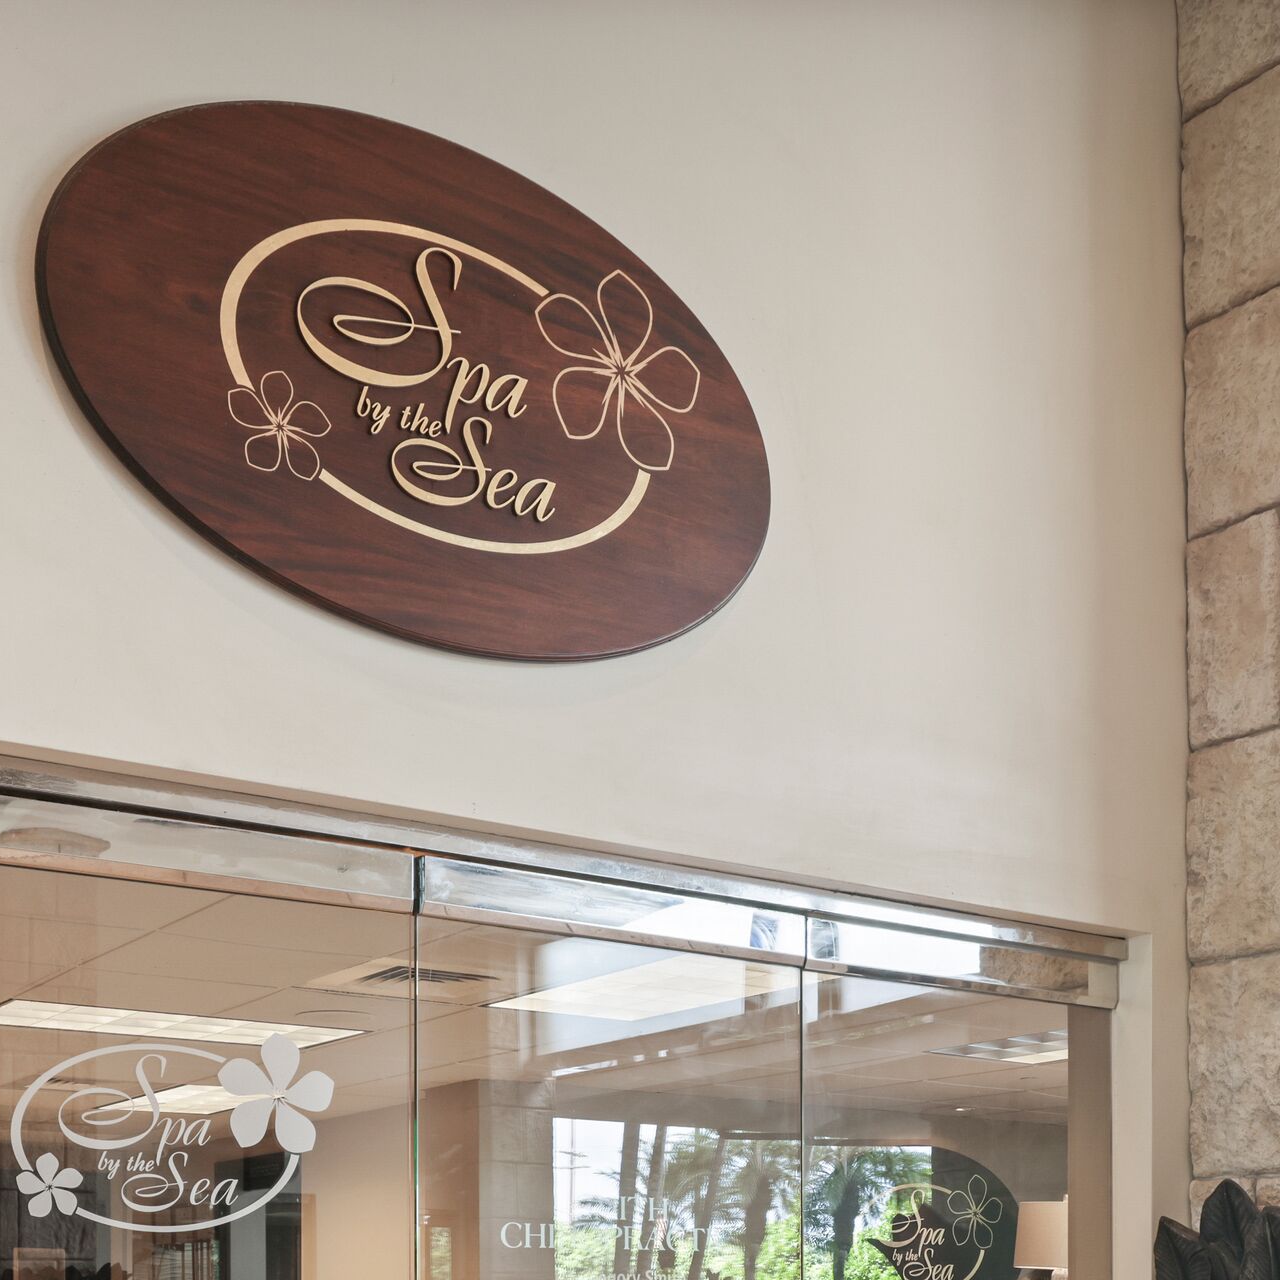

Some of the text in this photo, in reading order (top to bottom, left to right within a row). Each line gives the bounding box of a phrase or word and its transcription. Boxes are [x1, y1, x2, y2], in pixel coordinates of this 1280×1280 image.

[297, 247, 530, 433] Spa
[357, 385, 443, 438] by the
[391, 417, 557, 523] Sea
[58, 1054, 211, 1166] Spa
[98, 1151, 155, 1179] by the
[121, 1151, 238, 1212] Sea
[879, 1189, 945, 1258] Spa
[892, 1249, 919, 1266] by the
